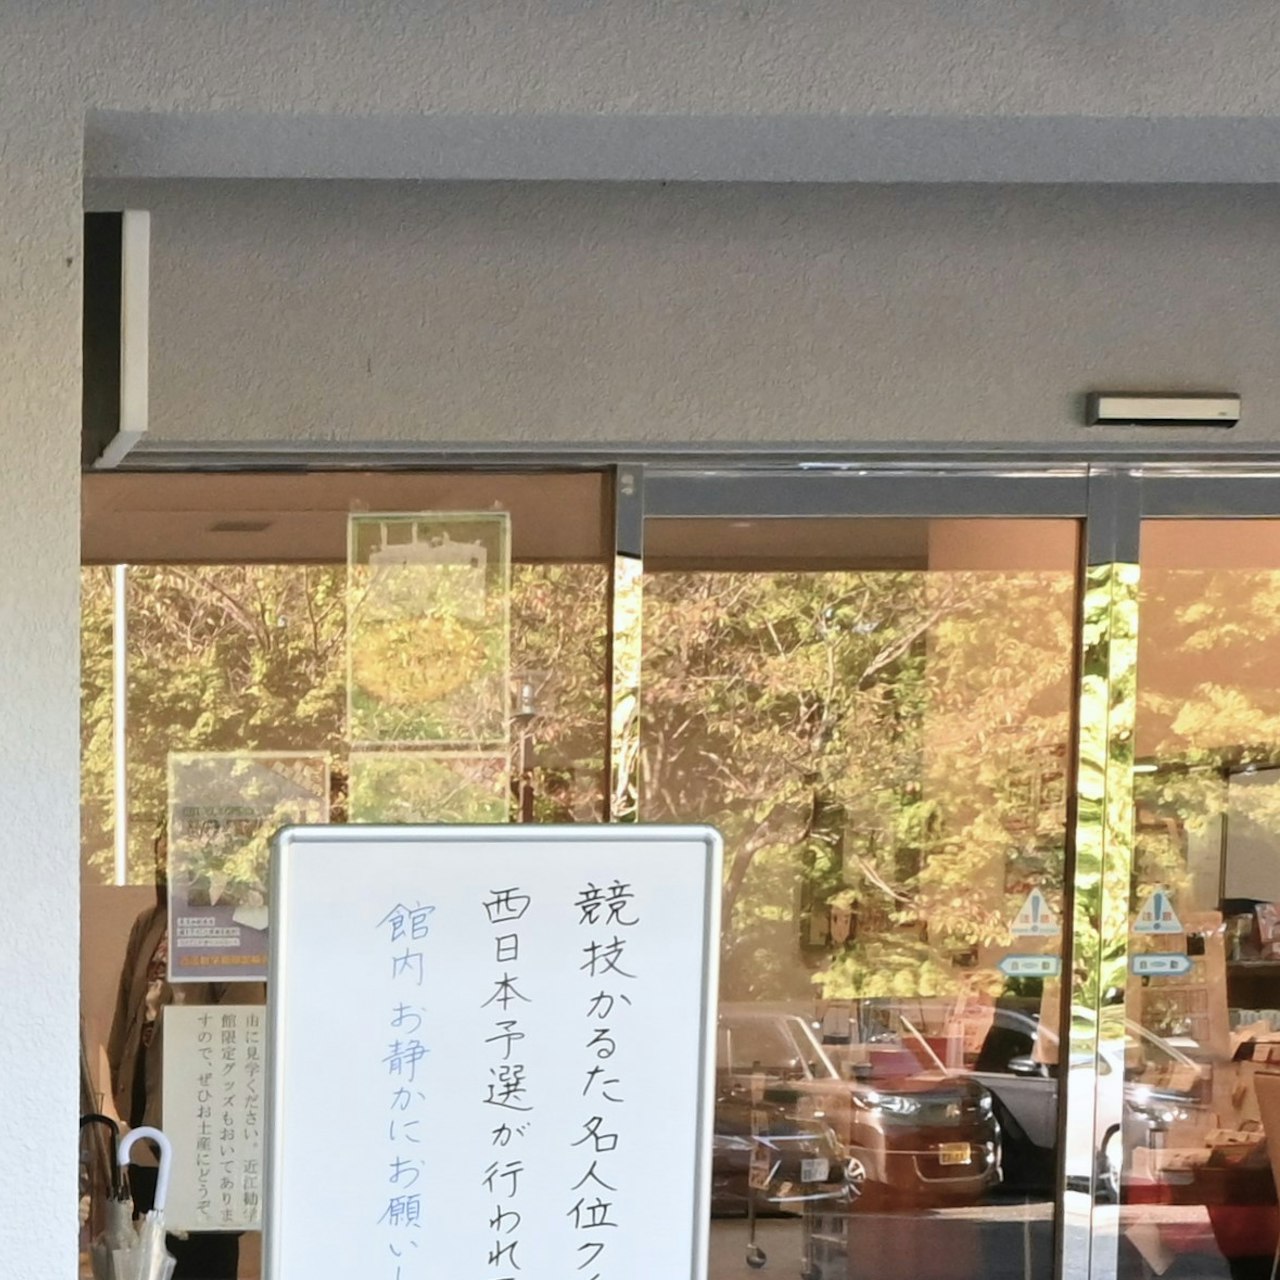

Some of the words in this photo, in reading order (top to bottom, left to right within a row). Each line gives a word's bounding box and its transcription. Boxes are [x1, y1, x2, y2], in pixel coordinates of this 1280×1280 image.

[219, 1012, 237, 1222] 館限定グッズもおいてありま
